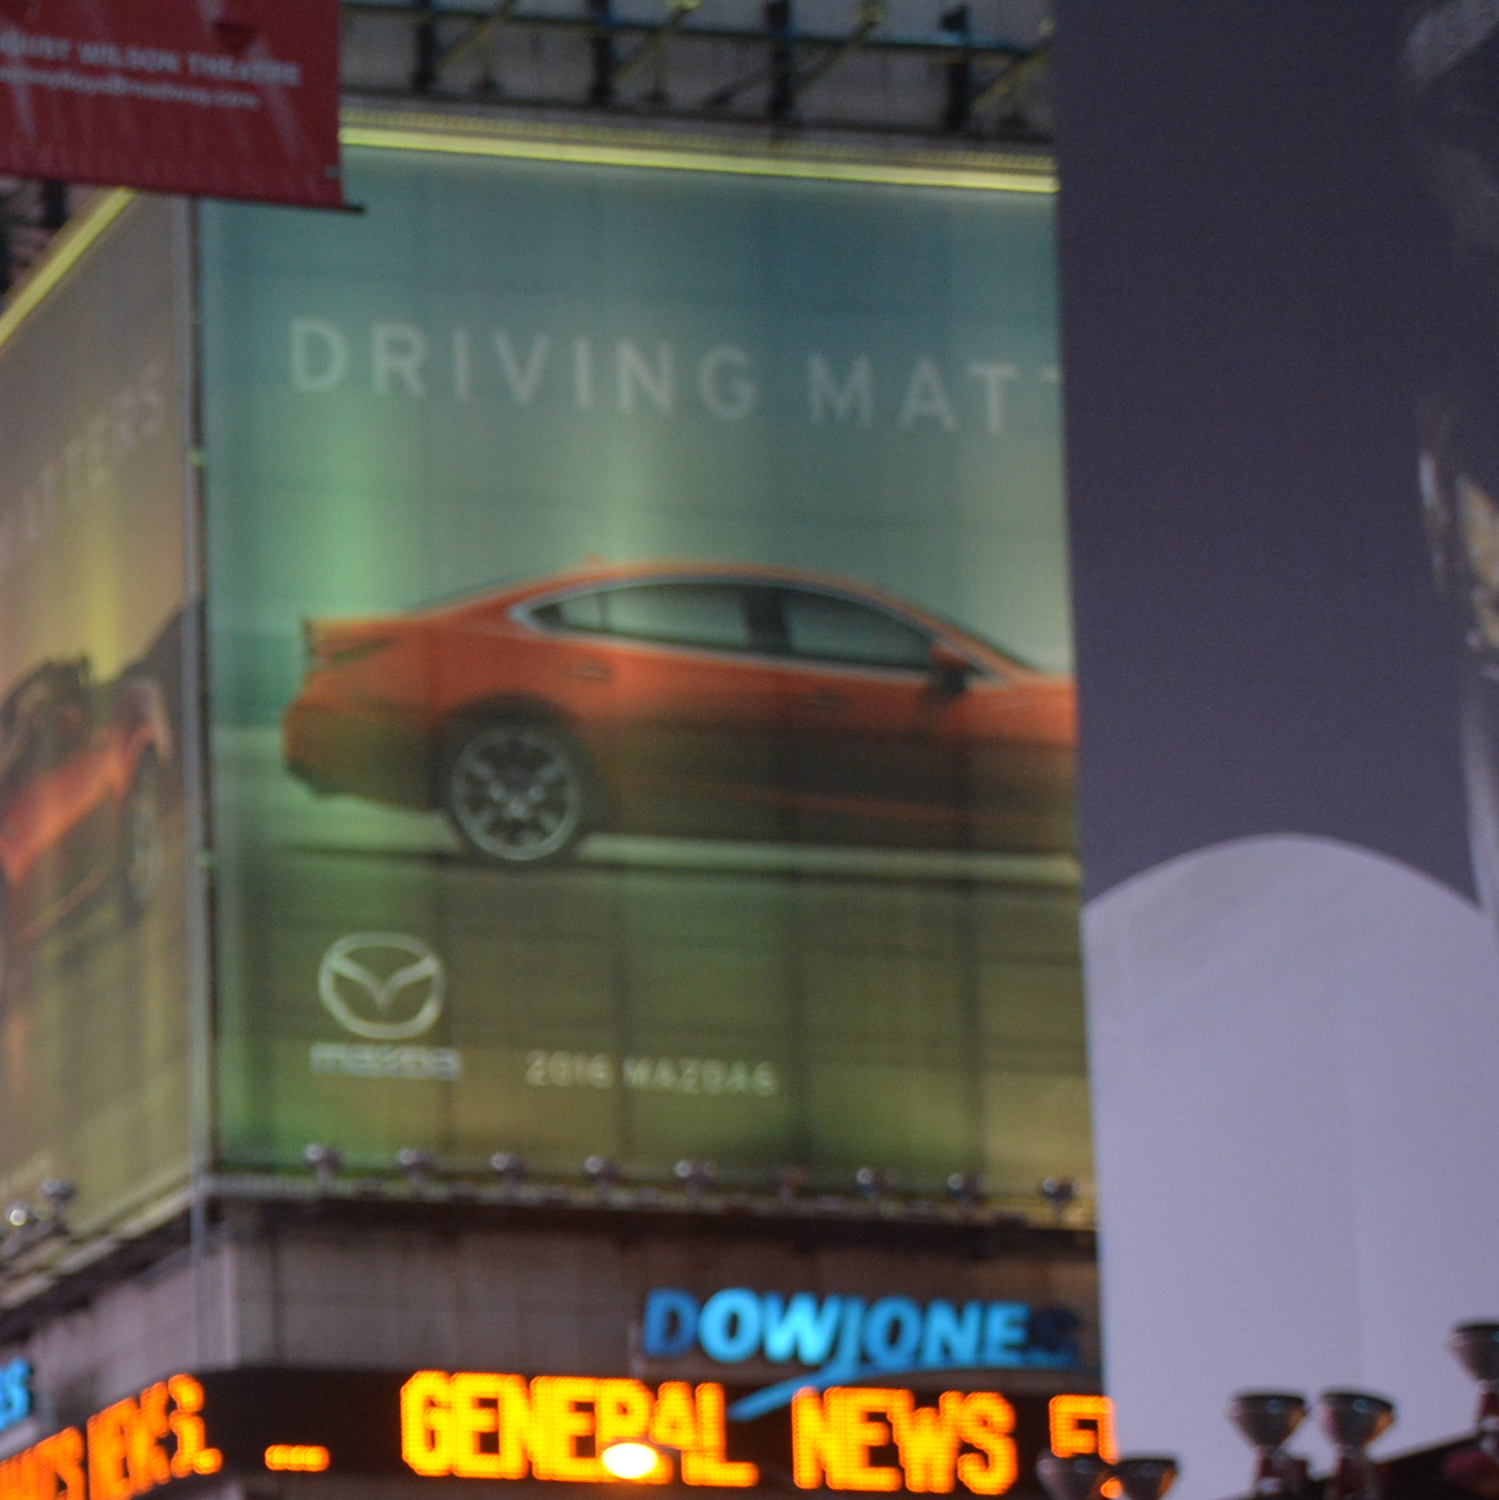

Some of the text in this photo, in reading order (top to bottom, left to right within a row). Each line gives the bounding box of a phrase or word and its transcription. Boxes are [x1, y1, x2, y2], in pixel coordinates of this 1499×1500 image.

[79, 43, 180, 76] WILSON
[189, 53, 301, 87] THEATRE
[288, 319, 1061, 437] DRIVING MAT
[524, 1049, 616, 1090] 2016
[401, 1371, 759, 1488] GENERAL
[791, 1386, 1018, 1494] NEWS
